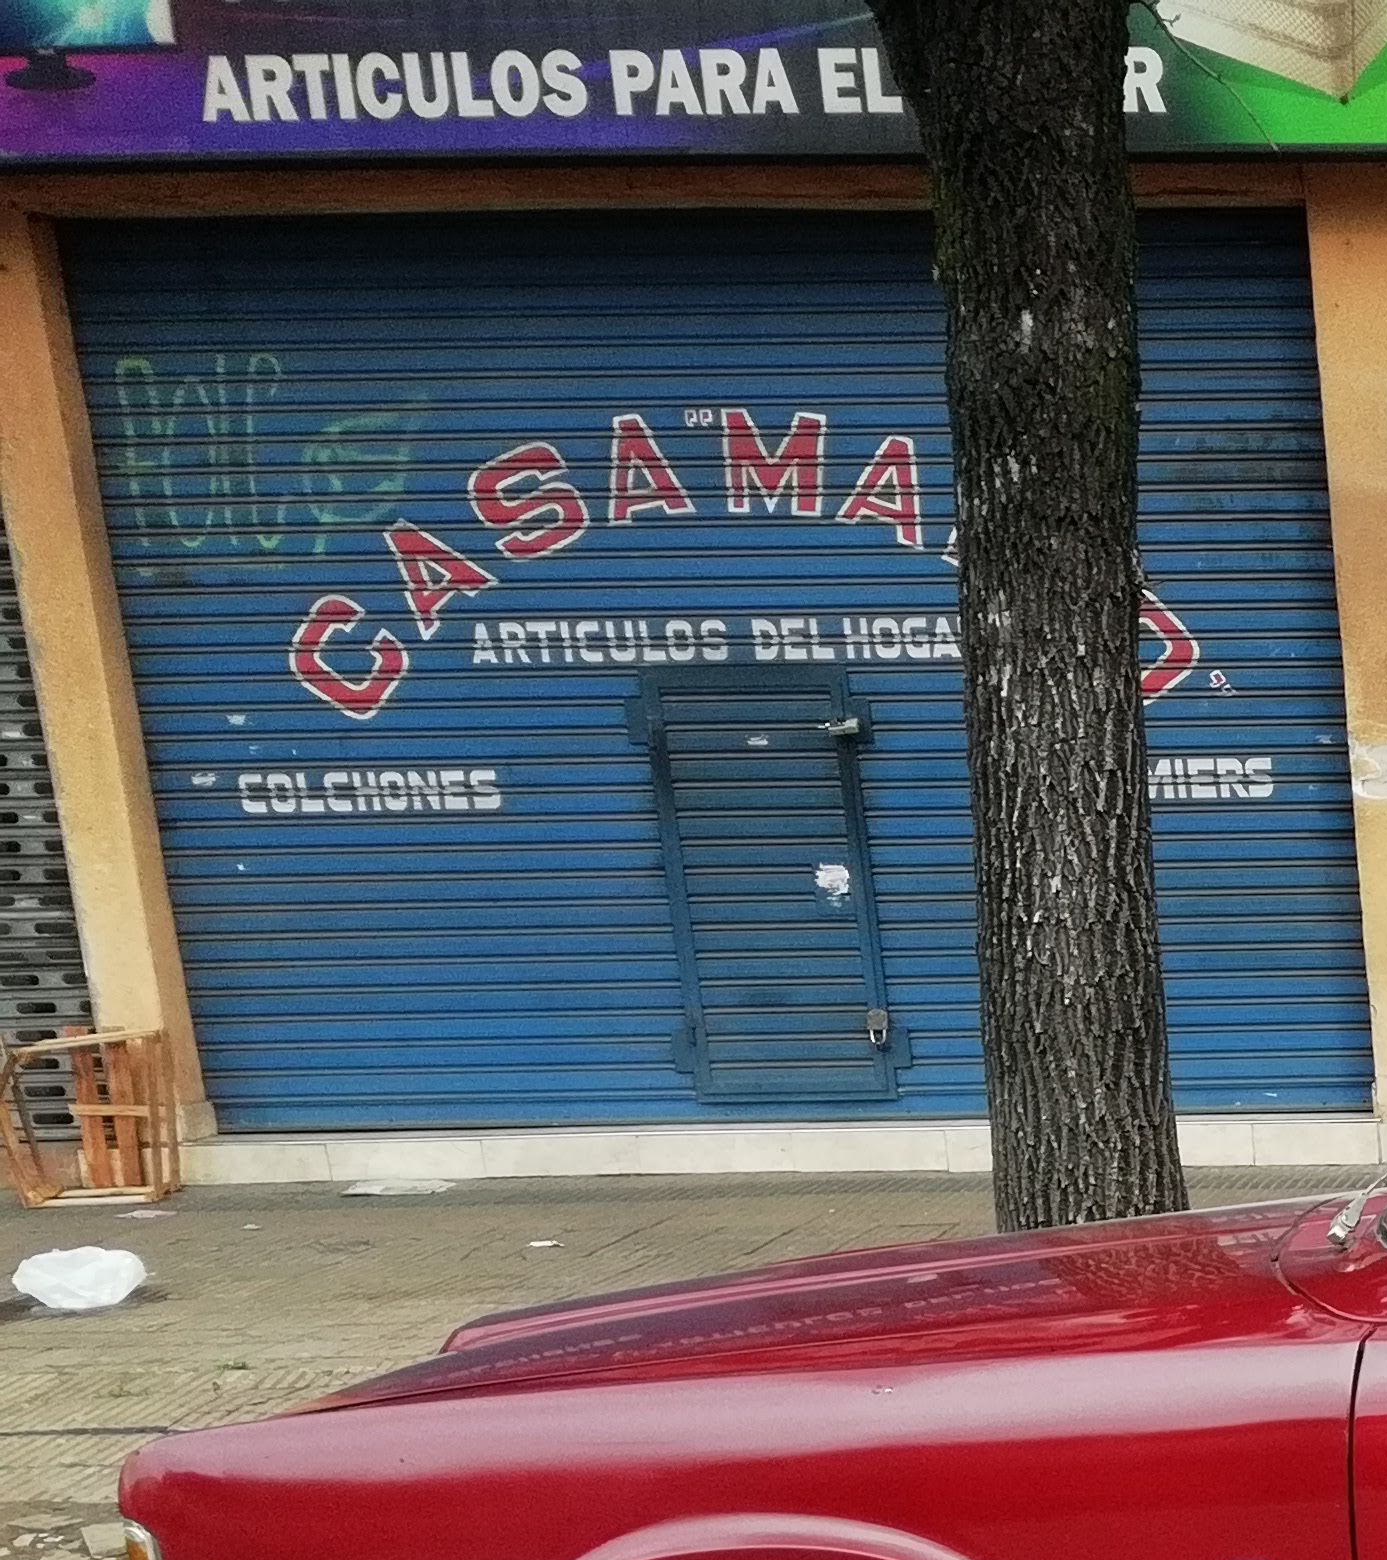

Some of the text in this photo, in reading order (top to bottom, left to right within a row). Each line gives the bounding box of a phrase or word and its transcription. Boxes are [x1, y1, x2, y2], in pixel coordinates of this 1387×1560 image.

[204, 47, 904, 122] ARTICULOS PARA EL
[288, 411, 697, 720] CASA
[473, 616, 962, 664] ARTICULOS DEL HOGA
[238, 757, 1274, 813] COLCHONES MIERS
